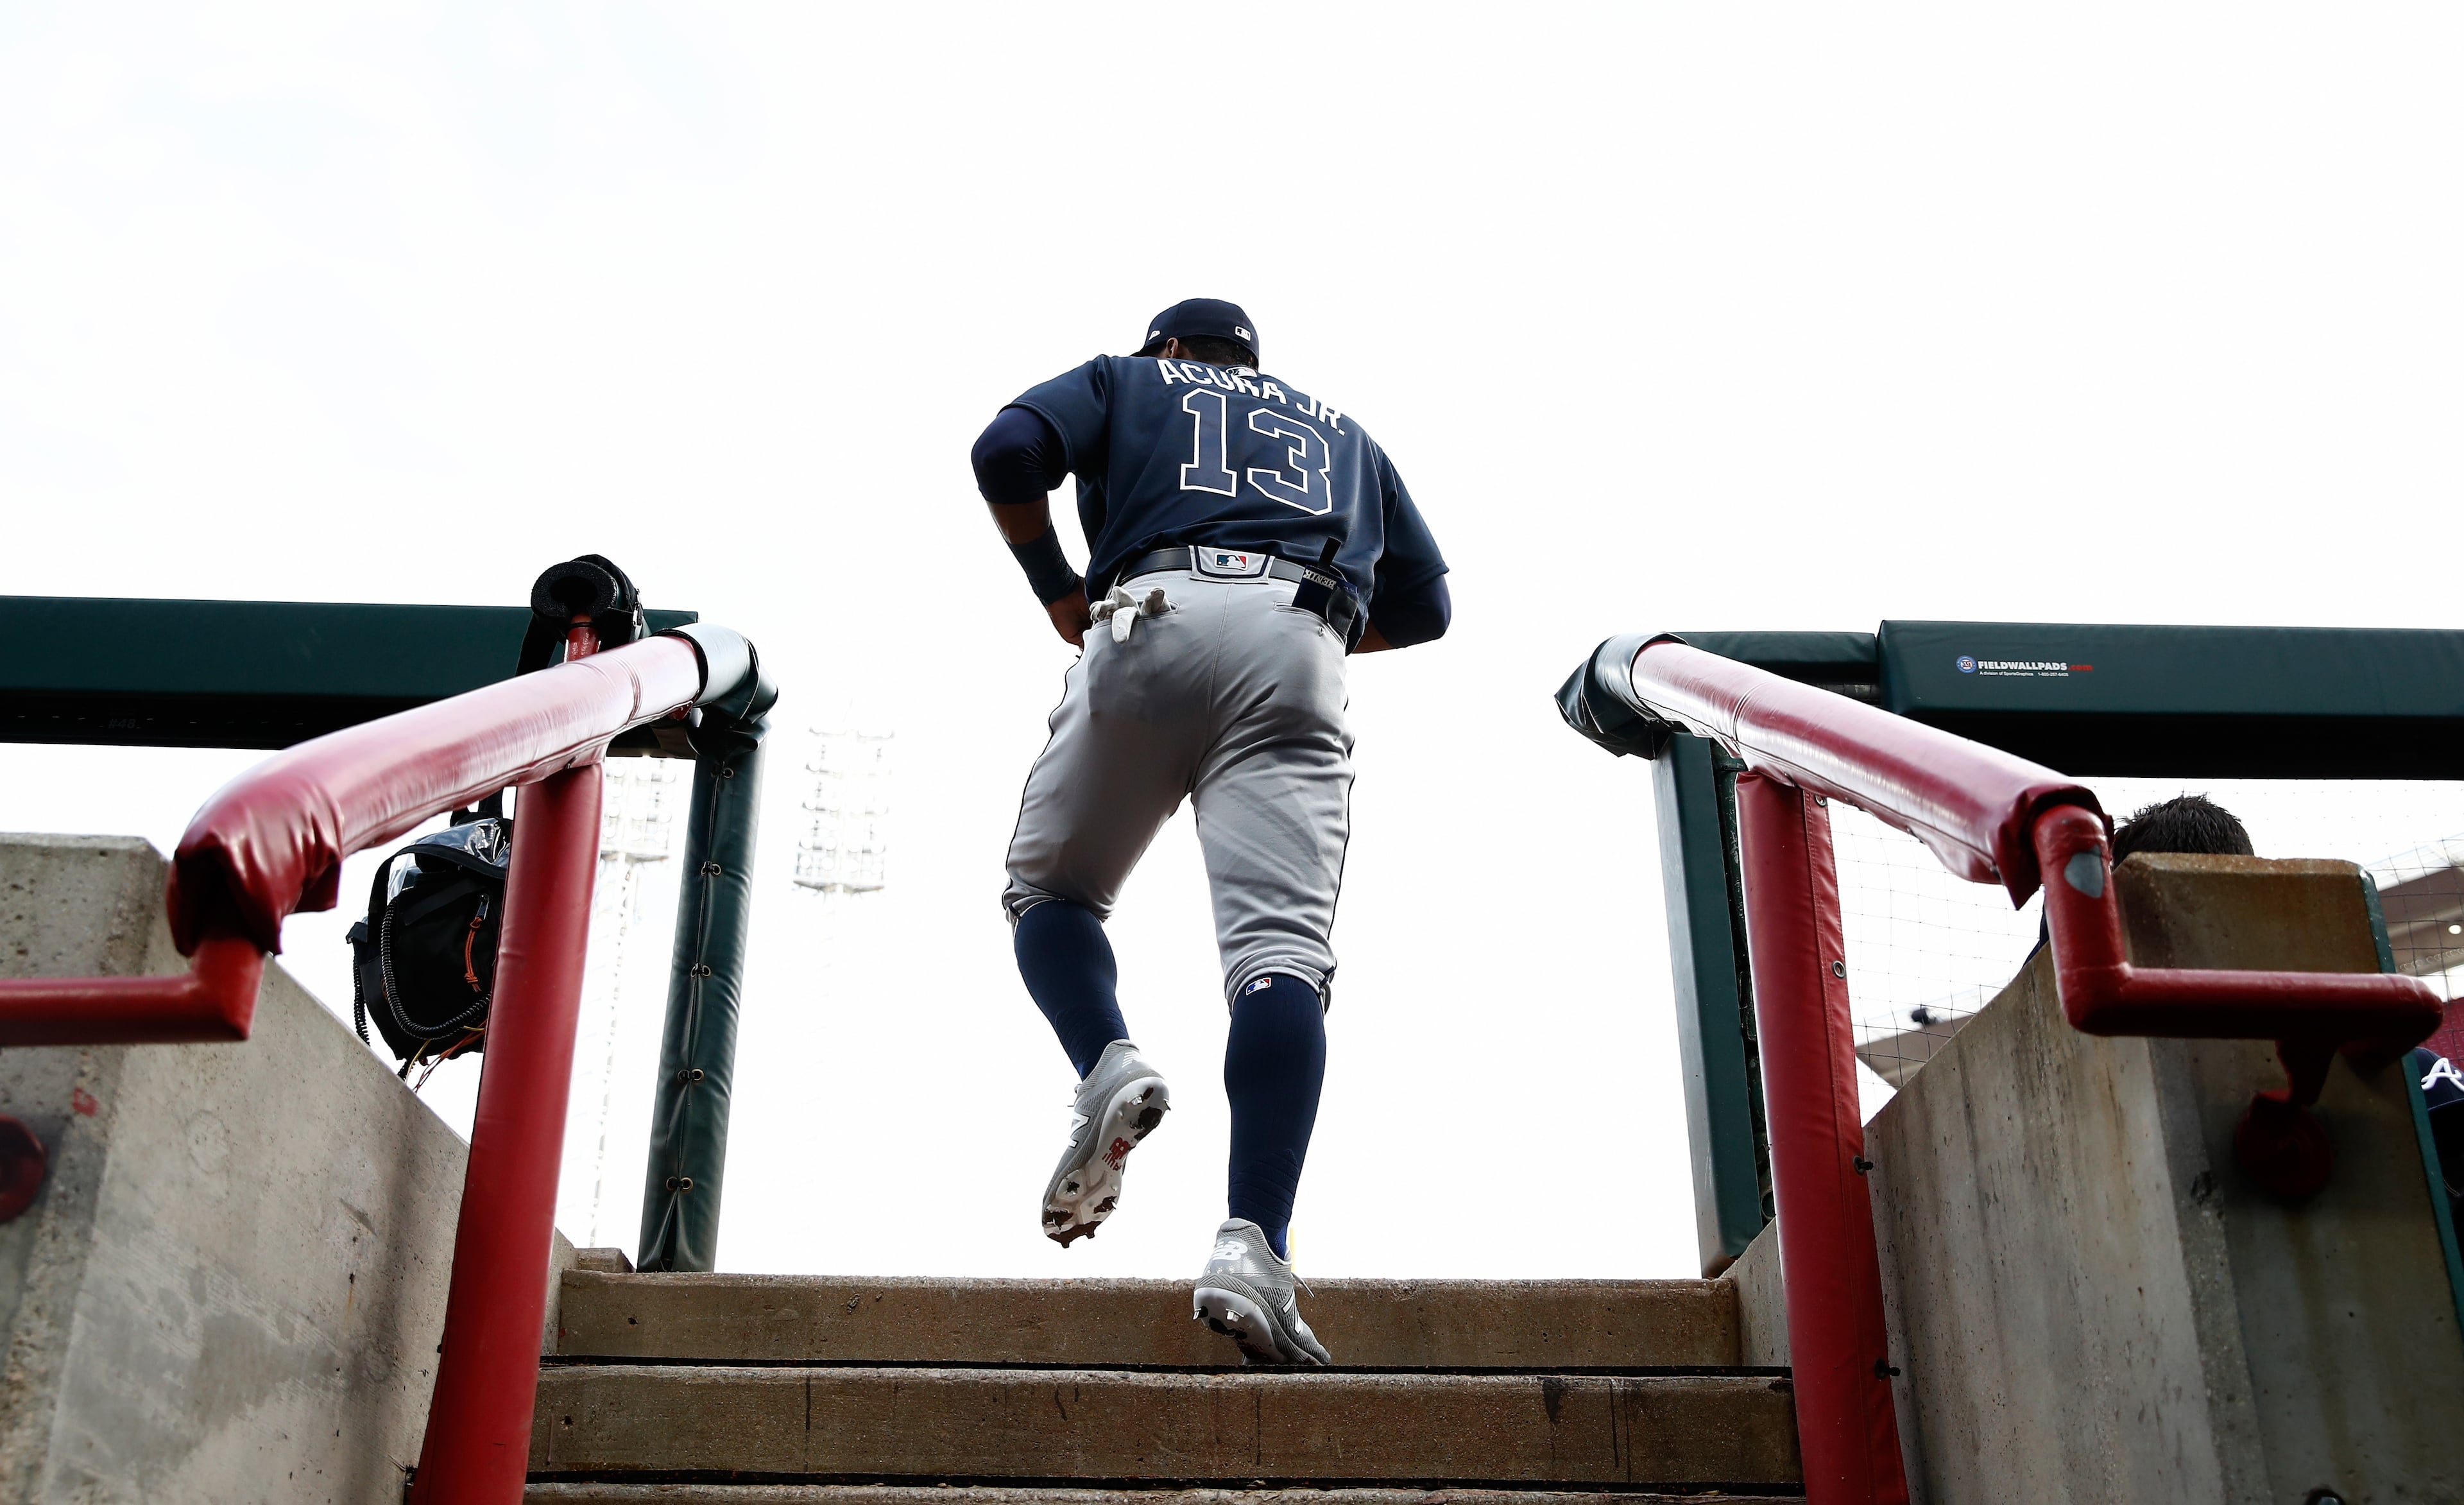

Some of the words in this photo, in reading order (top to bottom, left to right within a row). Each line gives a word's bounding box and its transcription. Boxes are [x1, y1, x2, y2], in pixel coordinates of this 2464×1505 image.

[1296, 396, 1346, 436] JR.
[1180, 388, 1333, 516] 13
[1978, 660, 2093, 671] FIELDWALLPADS.com
